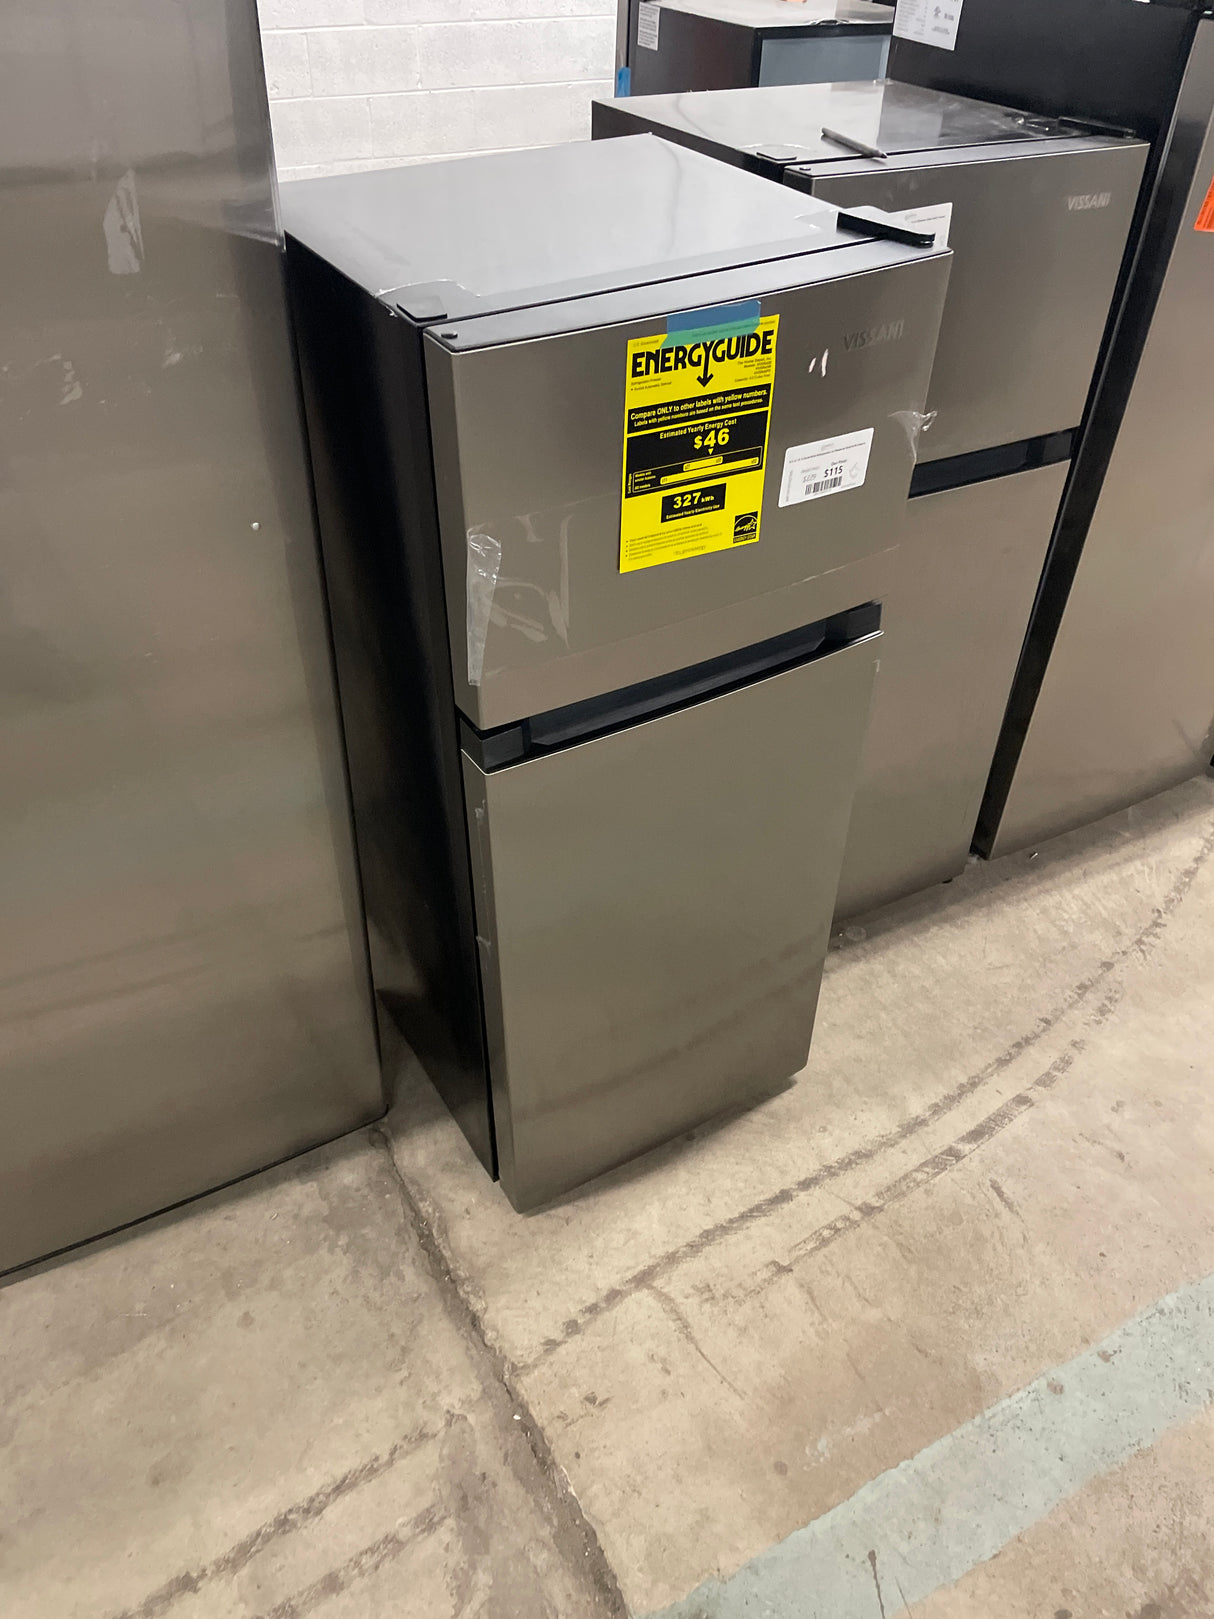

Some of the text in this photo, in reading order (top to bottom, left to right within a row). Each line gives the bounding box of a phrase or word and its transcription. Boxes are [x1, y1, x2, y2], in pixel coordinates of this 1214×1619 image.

[630, 409, 656, 421] Compare
[657, 406, 673, 415] ONLY
[680, 402, 695, 411] other
[695, 399, 711, 408] labels
[712, 396, 725, 404] with
[724, 394, 742, 404] yellow
[743, 389, 768, 399] numbers.
[659, 418, 737, 440] Estimated Yearly Energy Cost
[693, 427, 730, 450] $46
[823, 465, 844, 479] $115
[673, 491, 715, 509] 327 kWh
